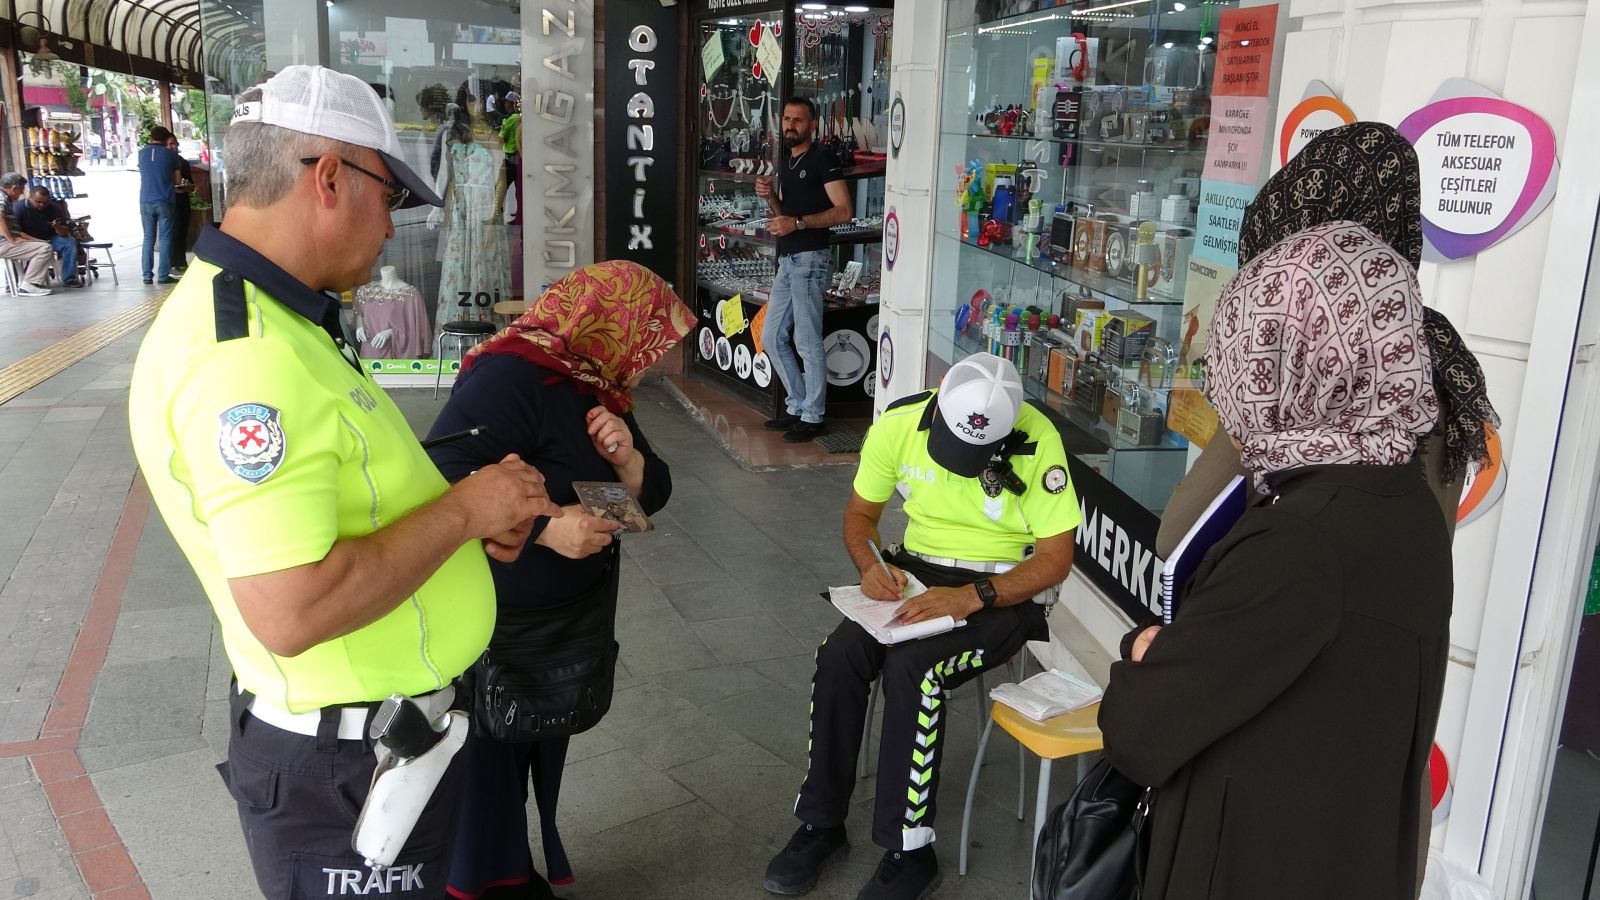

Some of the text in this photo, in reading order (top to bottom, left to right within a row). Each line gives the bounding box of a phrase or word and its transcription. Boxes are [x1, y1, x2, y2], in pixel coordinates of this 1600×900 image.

[1436, 131, 1515, 149] TÜM TELEFON
[1441, 156, 1502, 171] AKSESUAR
[1440, 176, 1497, 195] ÇEŞİTLERİ
[1205, 192, 1225, 207] AKILLI
[1438, 199, 1492, 215] BULUNUR
[1208, 214, 1240, 232] SAATLERİ
[1075, 495, 1165, 617] MERKE
